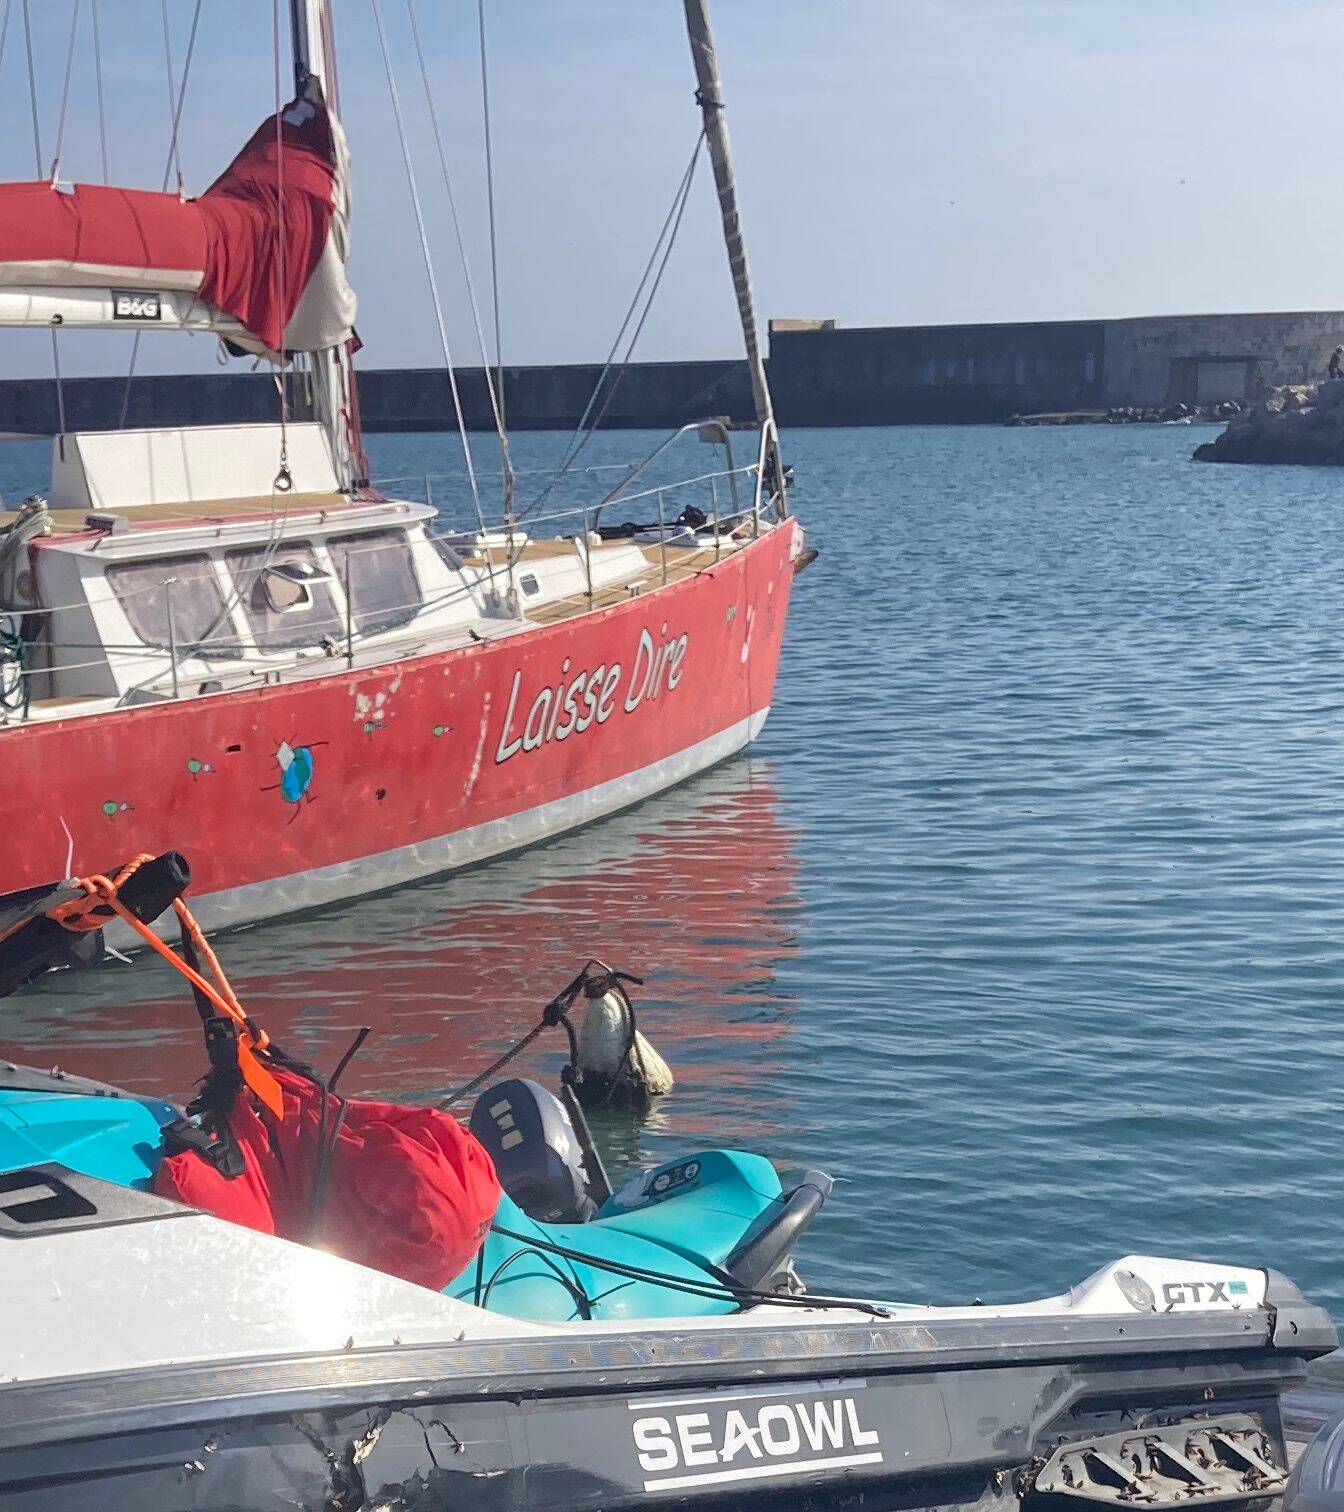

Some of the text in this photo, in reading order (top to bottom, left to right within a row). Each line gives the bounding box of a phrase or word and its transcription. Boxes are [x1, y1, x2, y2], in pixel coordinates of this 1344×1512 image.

[117, 296, 158, 317] B&G
[495, 620, 690, 764] Laisse Dire
[1162, 1280, 1231, 1304] GTX
[632, 1398, 880, 1472] SEAOWL
